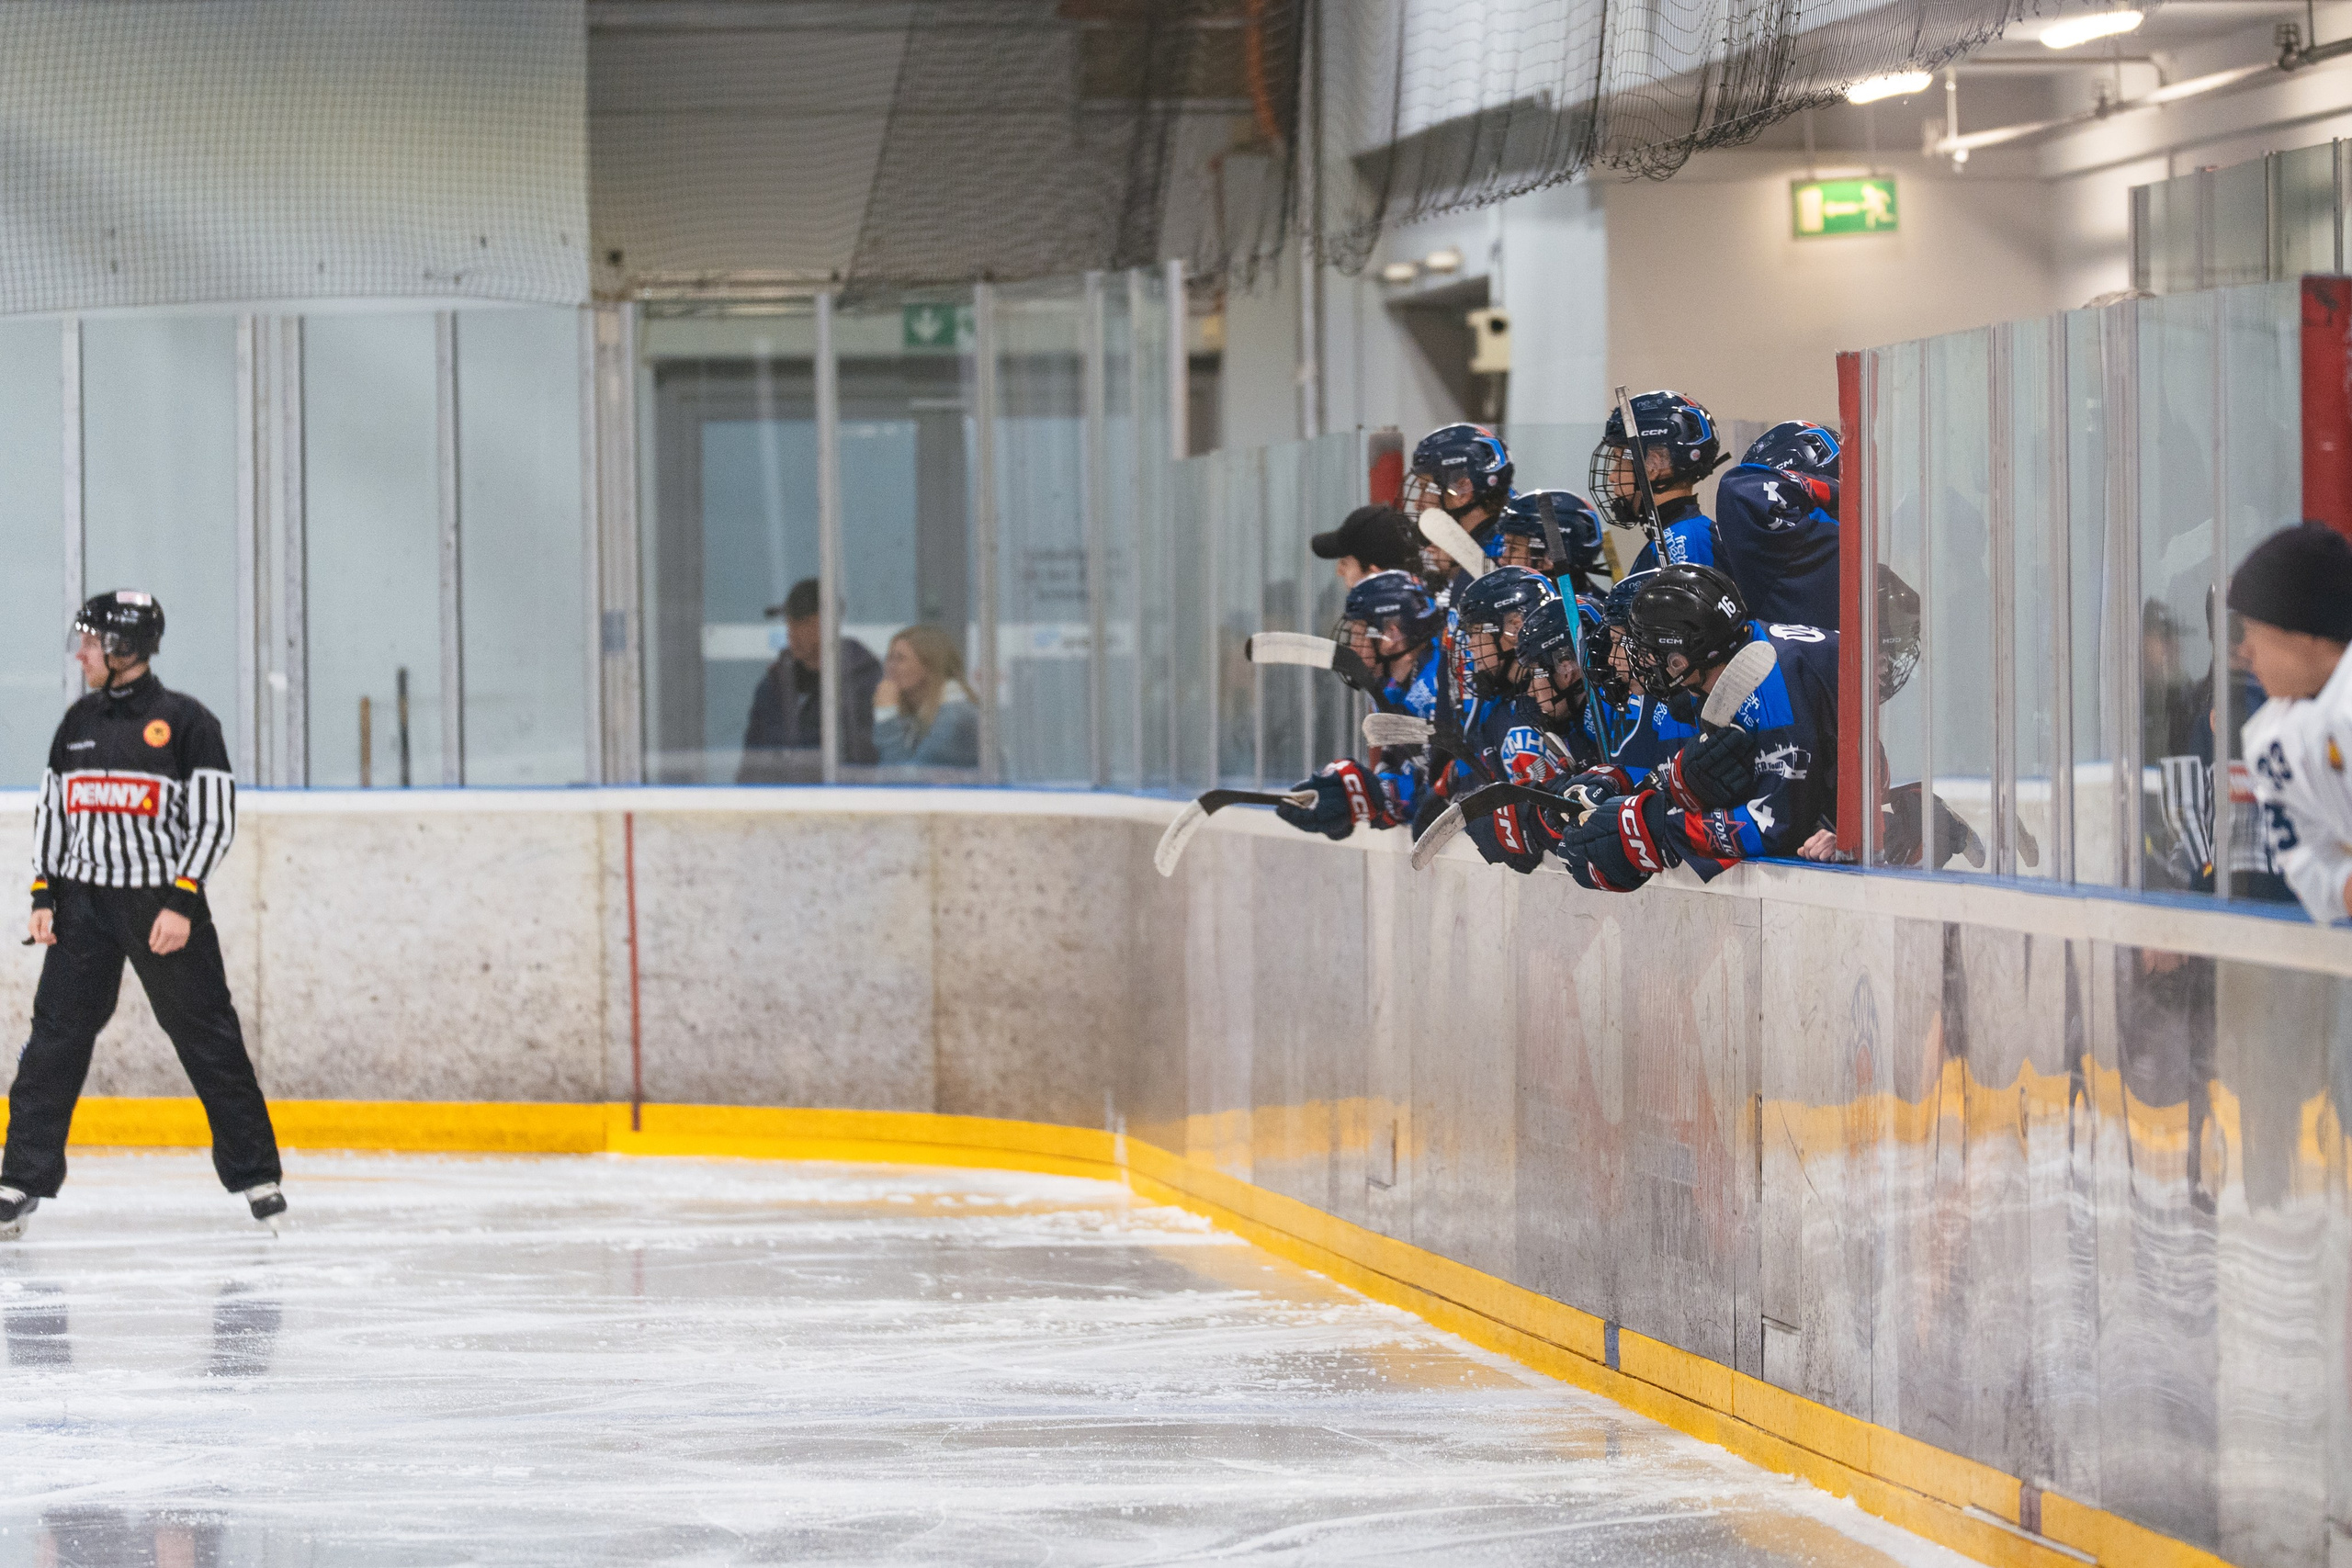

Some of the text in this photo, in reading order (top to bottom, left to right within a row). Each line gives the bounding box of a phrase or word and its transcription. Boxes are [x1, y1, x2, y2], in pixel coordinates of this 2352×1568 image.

[1640, 428, 1668, 436] CCM
[1675, 535, 1689, 563] fret
[1717, 595, 1736, 619] 16
